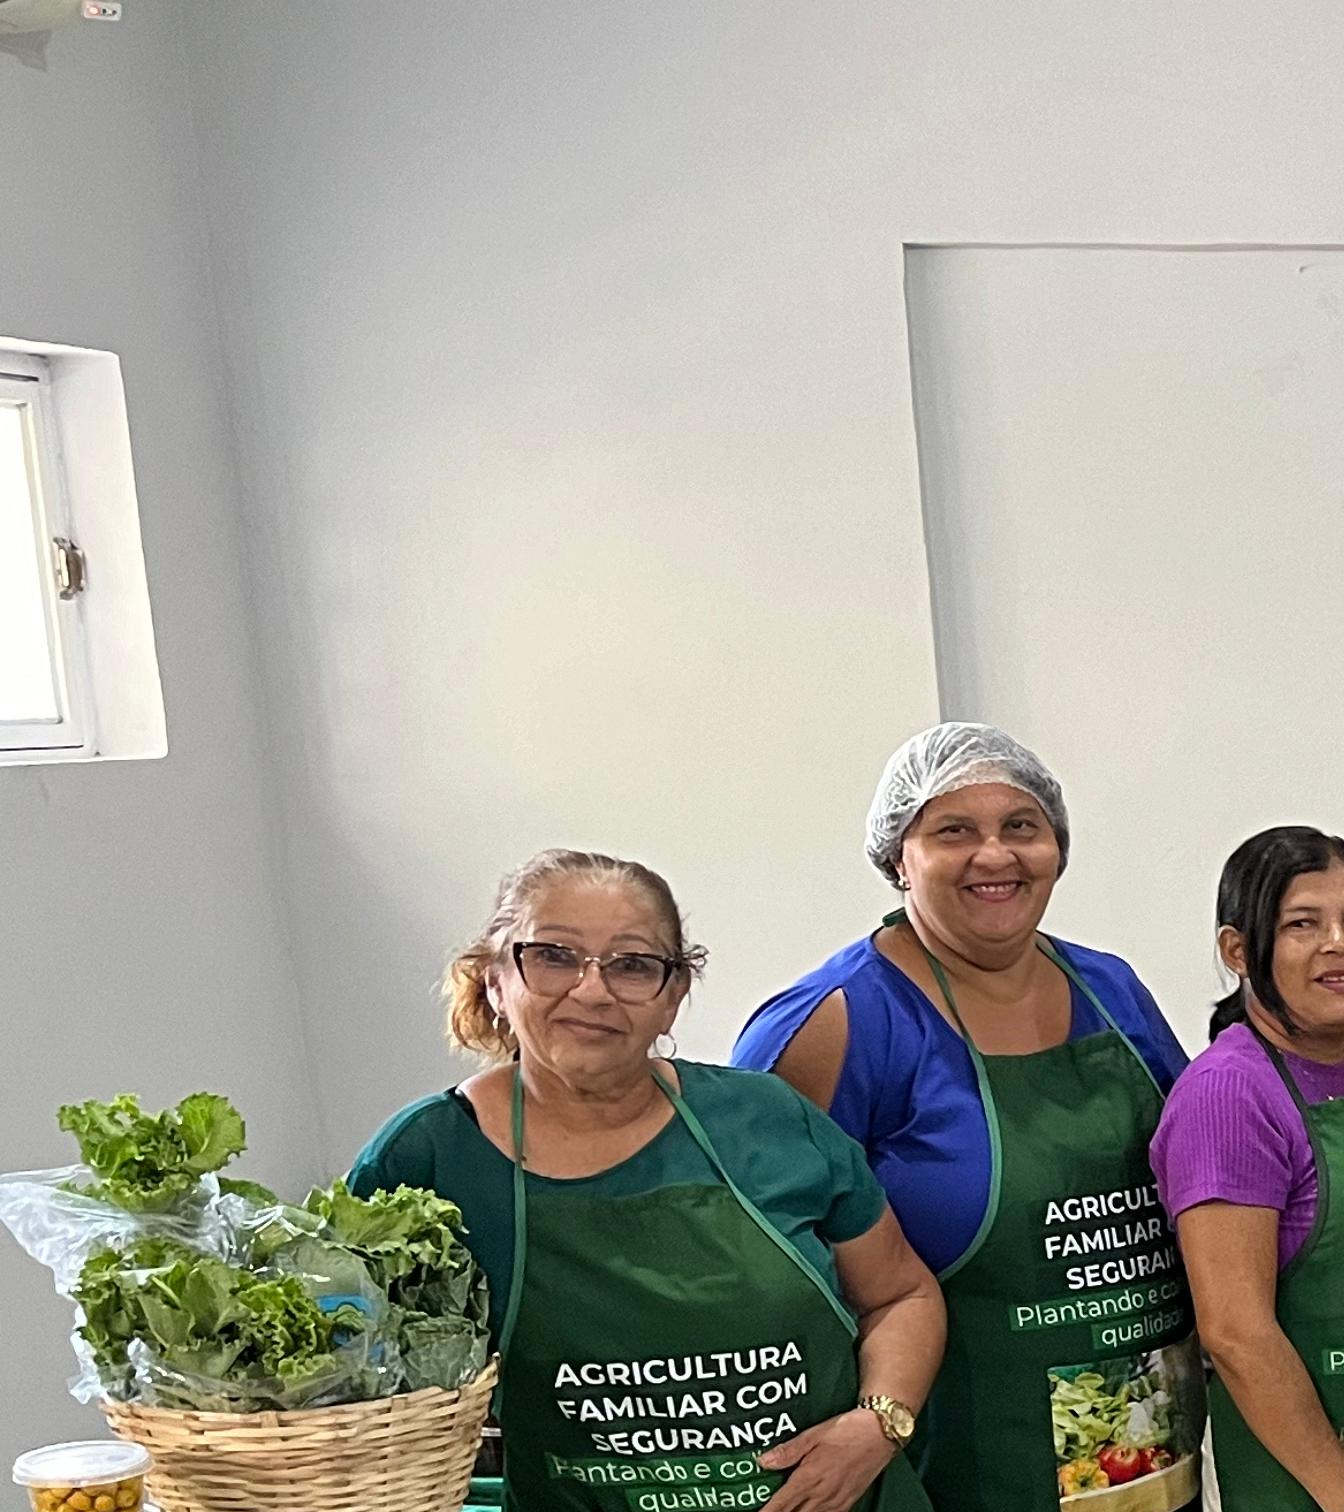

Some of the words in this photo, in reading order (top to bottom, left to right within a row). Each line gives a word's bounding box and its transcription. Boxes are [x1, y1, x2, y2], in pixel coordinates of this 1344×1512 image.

[1044, 1217, 1162, 1260] FAMILIAR
[1016, 1289, 1145, 1328] Plantando
[1148, 1288, 1158, 1304] e
[554, 1340, 803, 1389] AGRICULTURA
[557, 1390, 727, 1424] FAMILIAR
[735, 1373, 808, 1411] COM
[591, 1411, 797, 1456] SEGURANÇA
[693, 1462, 711, 1480] e
